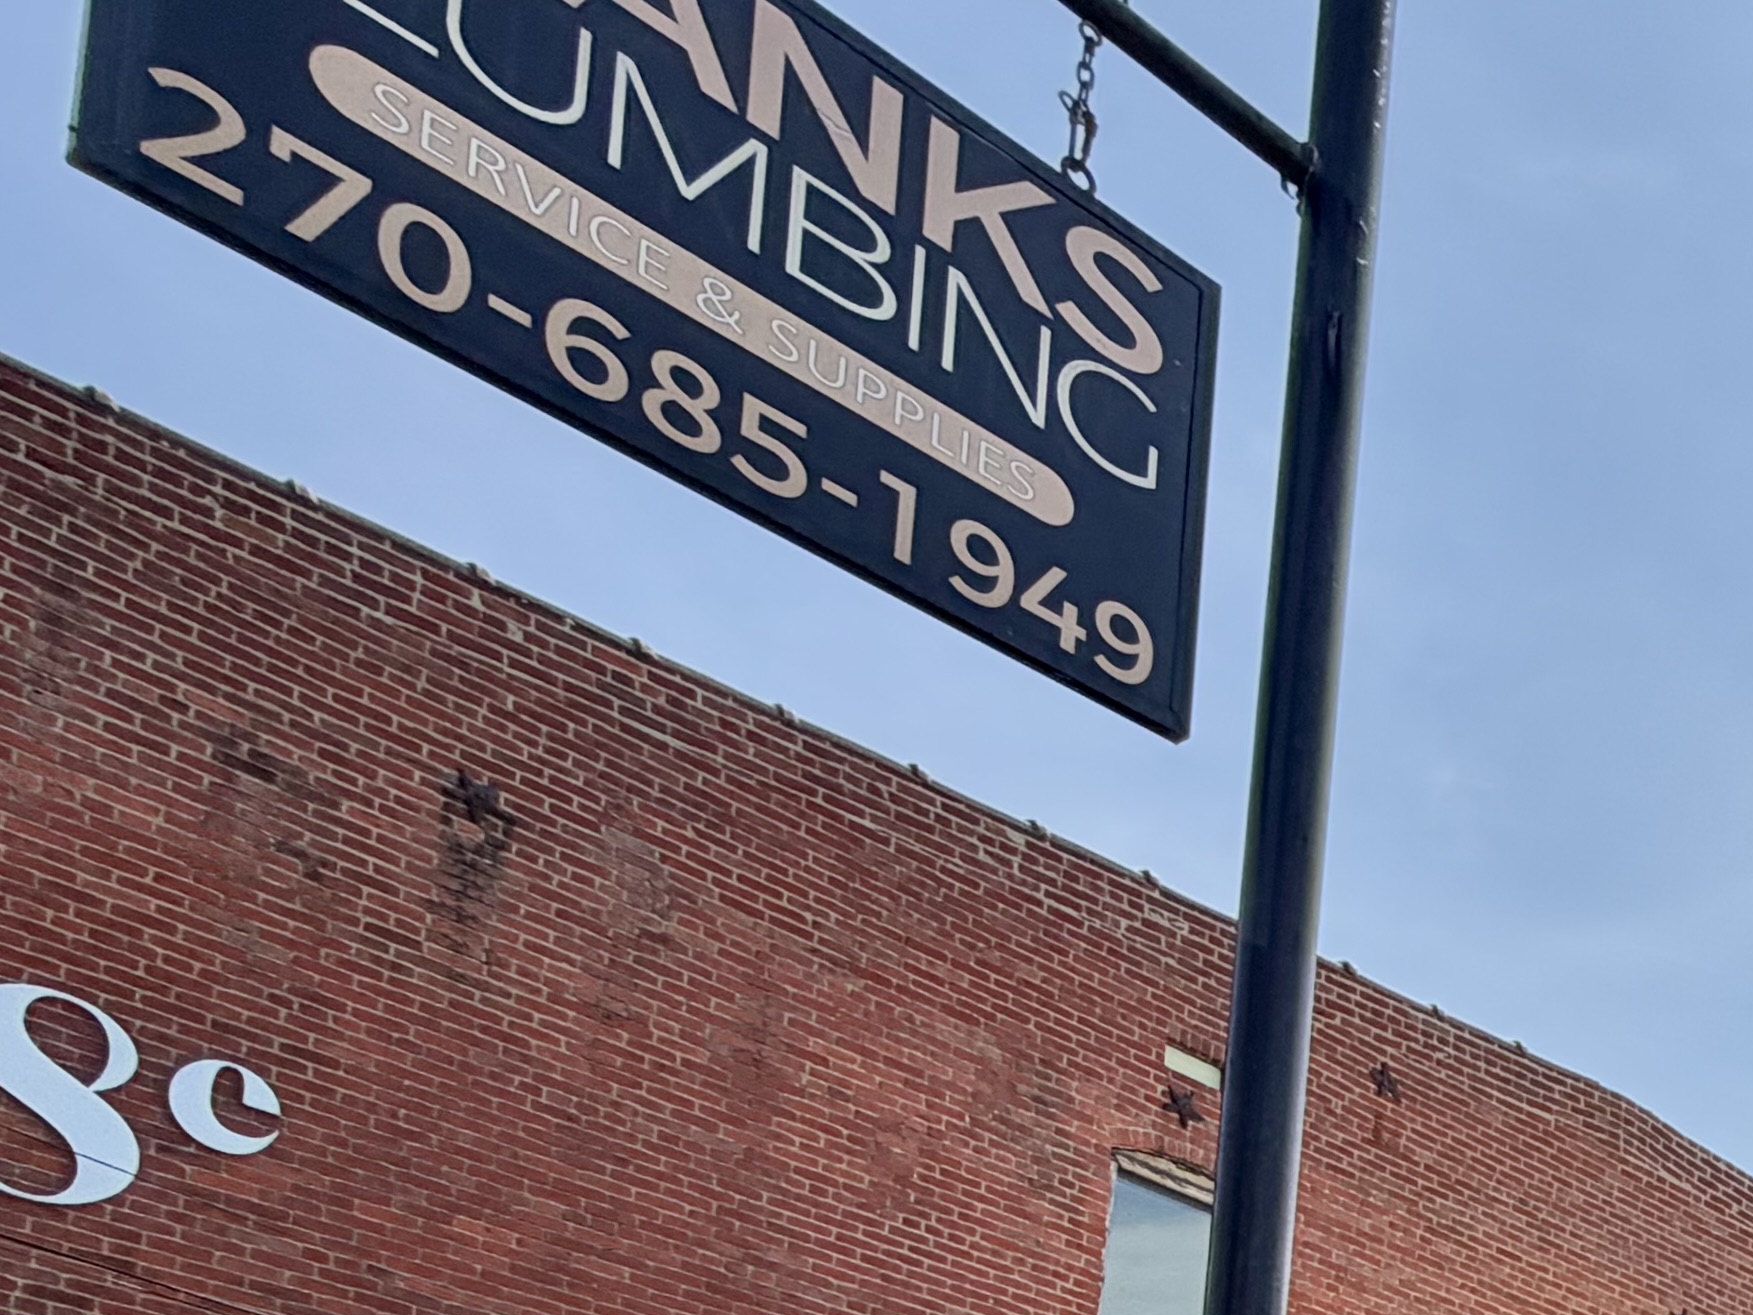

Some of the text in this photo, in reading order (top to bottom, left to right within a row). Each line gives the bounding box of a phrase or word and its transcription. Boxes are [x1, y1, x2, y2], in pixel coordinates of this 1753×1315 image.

[139, 66, 1155, 686] 270-685-1949
[343, 0, 1159, 490] UMBING
[370, 82, 1037, 502] SERVICE & SUPPLIES
